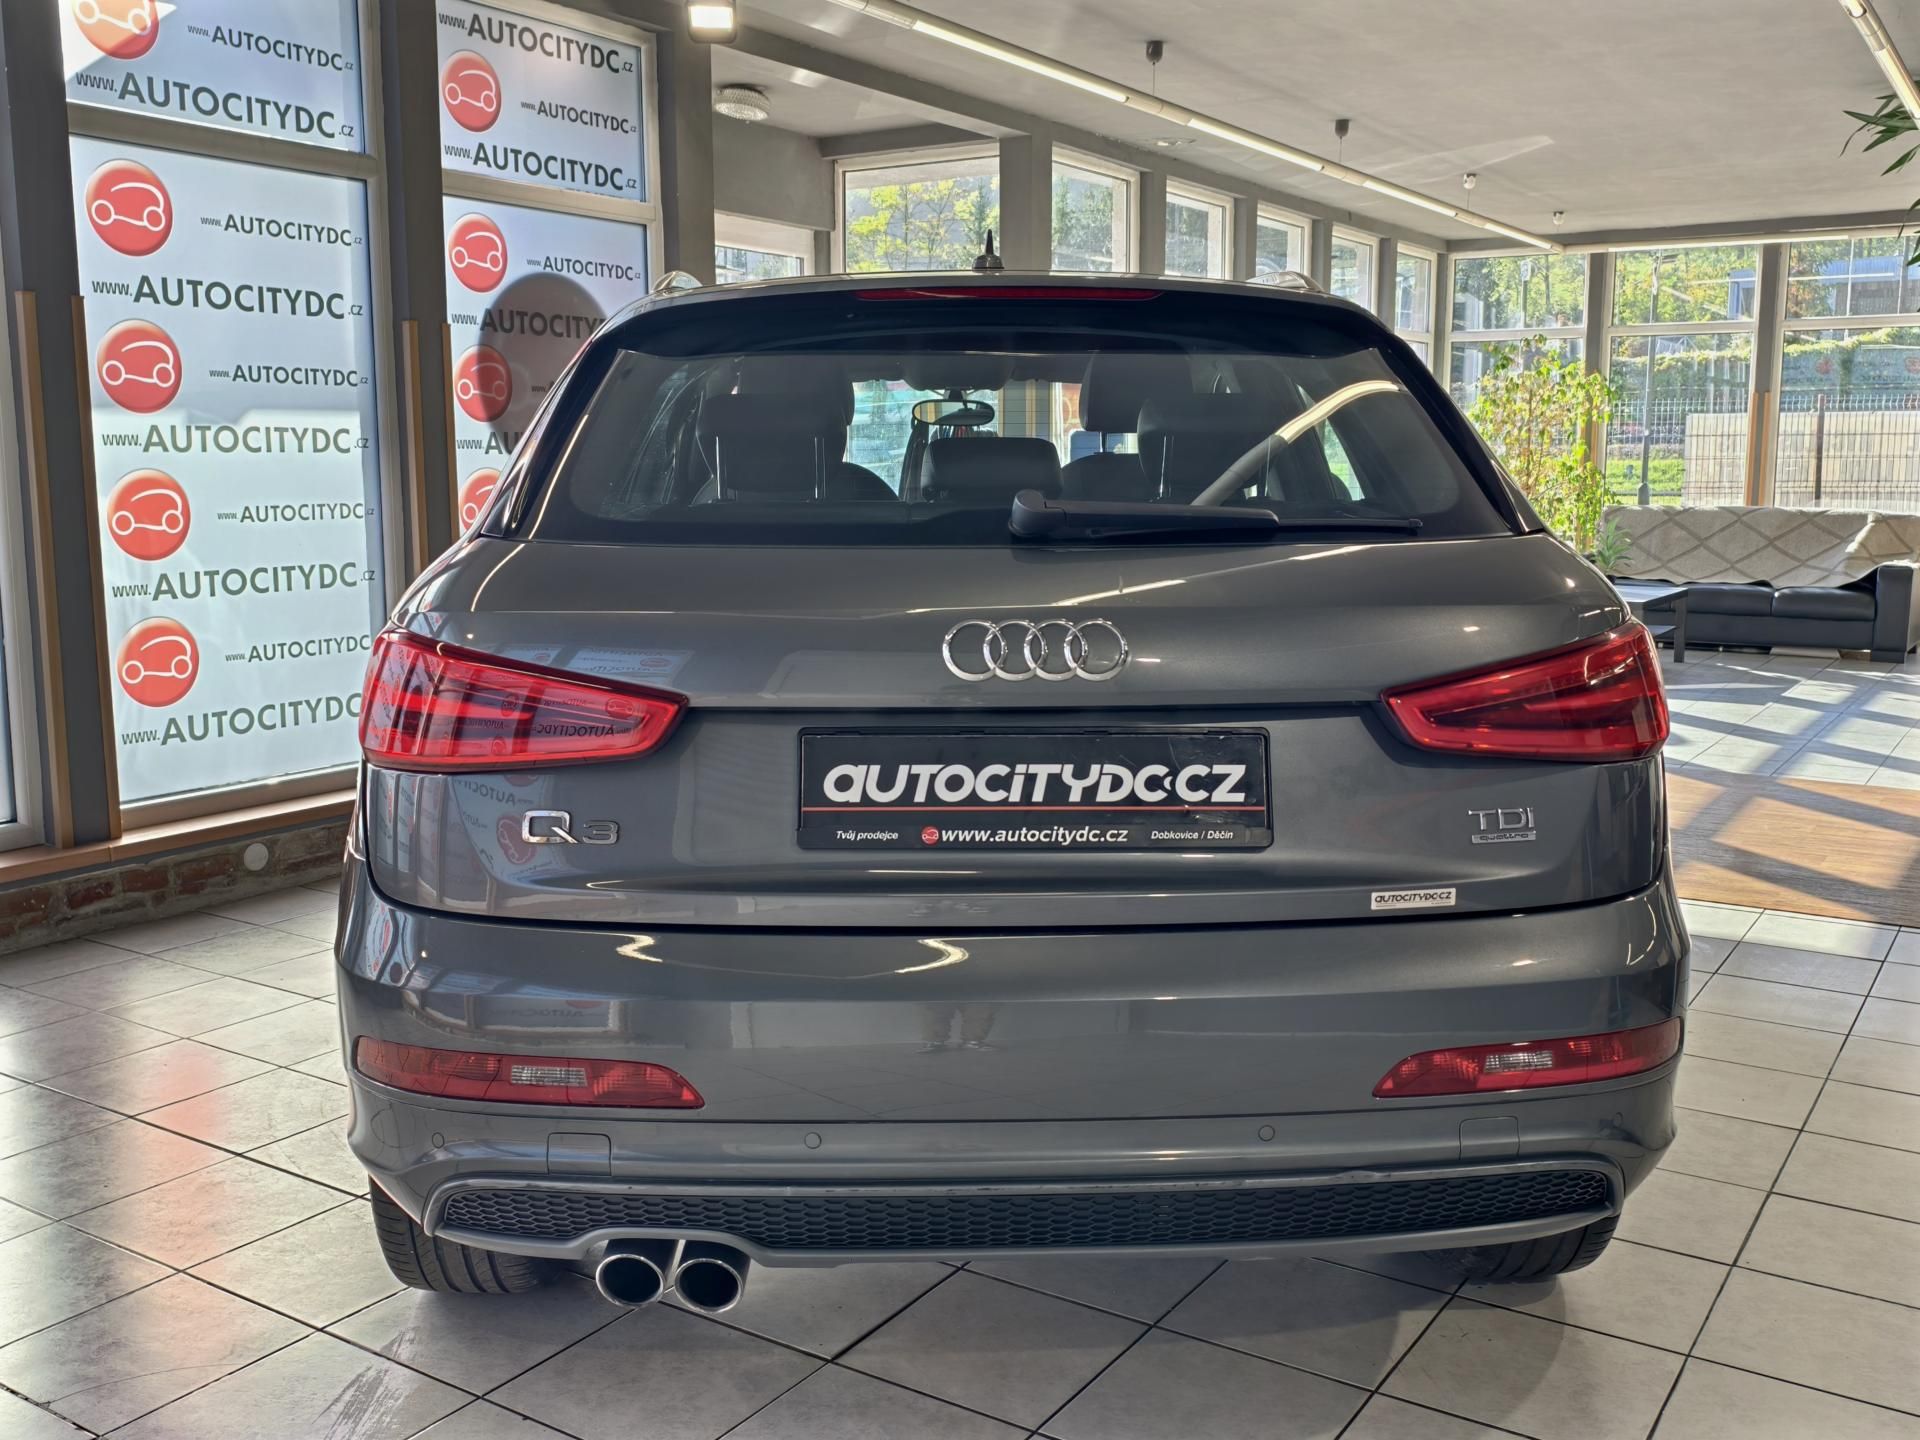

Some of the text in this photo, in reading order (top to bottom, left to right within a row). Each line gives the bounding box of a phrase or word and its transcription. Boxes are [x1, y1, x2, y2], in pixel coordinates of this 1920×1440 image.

[75, 71, 355, 139] www.AUTOCITYDC.cz
[91, 274, 363, 320] www.AUTOCITYDC.cz
[102, 425, 369, 454] www.AUTOCITYDC.cz
[456, 431, 524, 456] www.AU
[112, 562, 375, 602] www.AUTOCITYDC.cz
[522, 809, 619, 845] Q3
[1467, 807, 1535, 831] TDI
[857, 830, 899, 841] prodejce
[941, 826, 1129, 845] www.autocitydc.cz
[1151, 830, 1199, 841] Dobkovice
